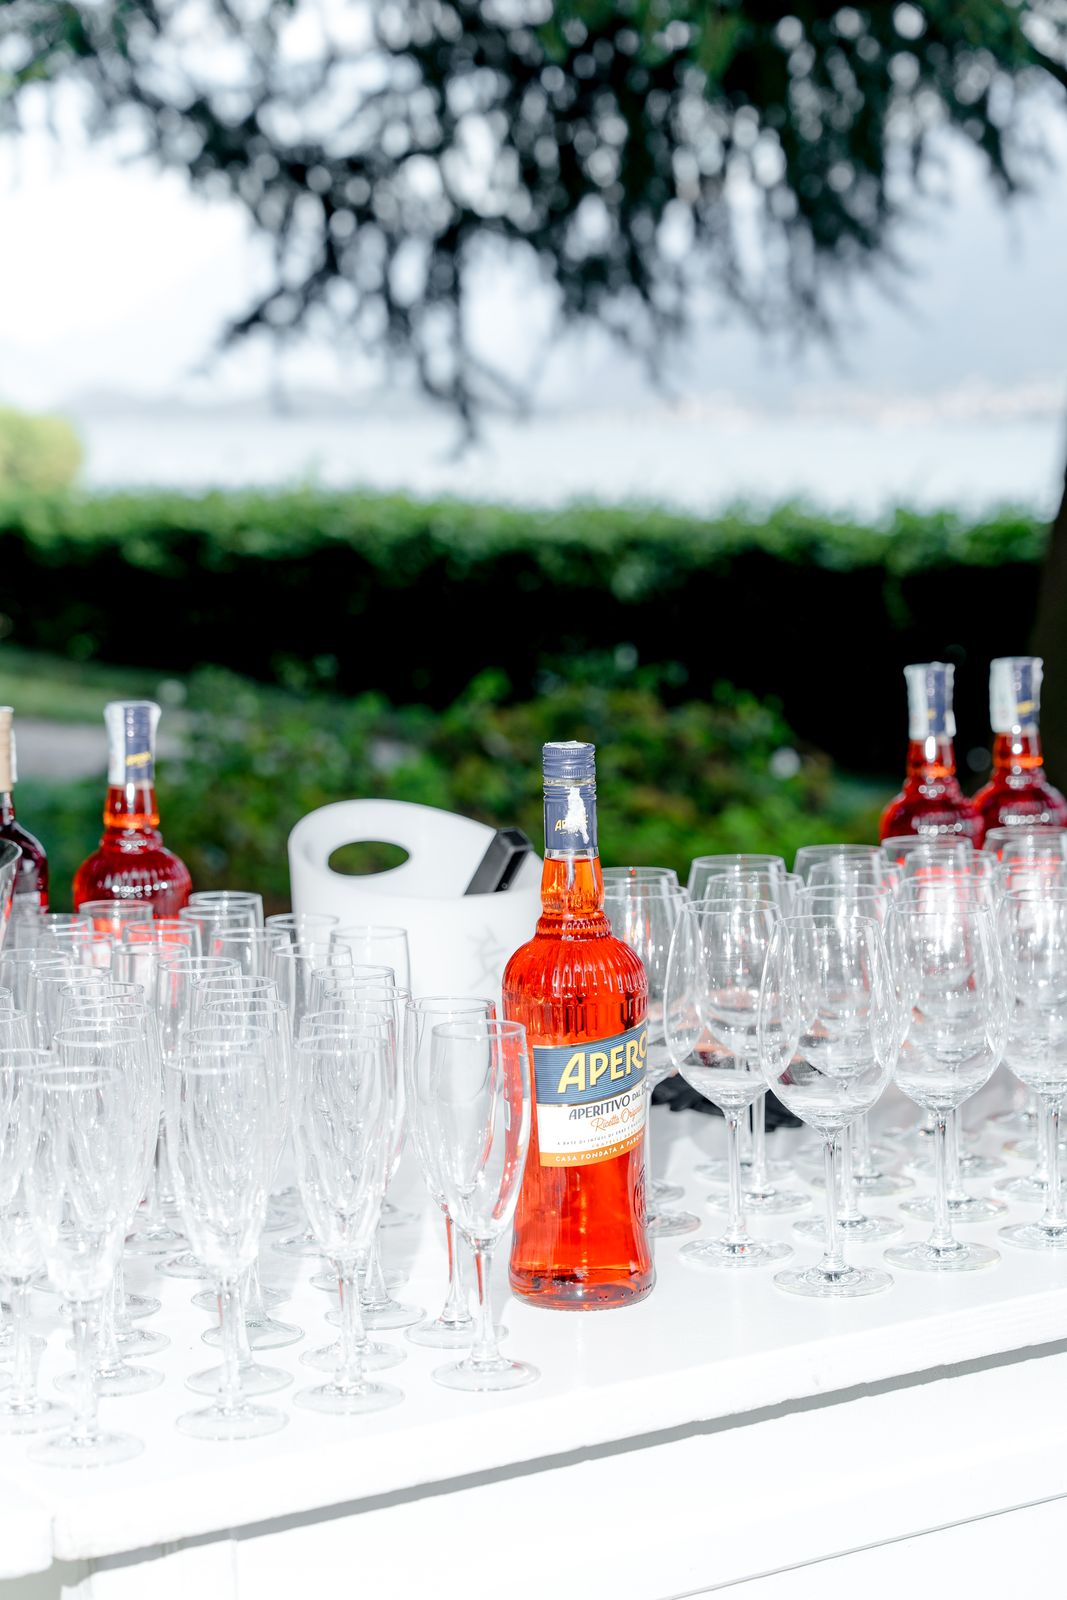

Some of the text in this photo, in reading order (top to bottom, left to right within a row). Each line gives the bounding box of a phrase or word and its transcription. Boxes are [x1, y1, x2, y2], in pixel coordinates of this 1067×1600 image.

[568, 1094, 631, 1121] APERITIVO
[590, 1112, 620, 1132] Ricetta
[580, 1145, 618, 1160] FONDATA
